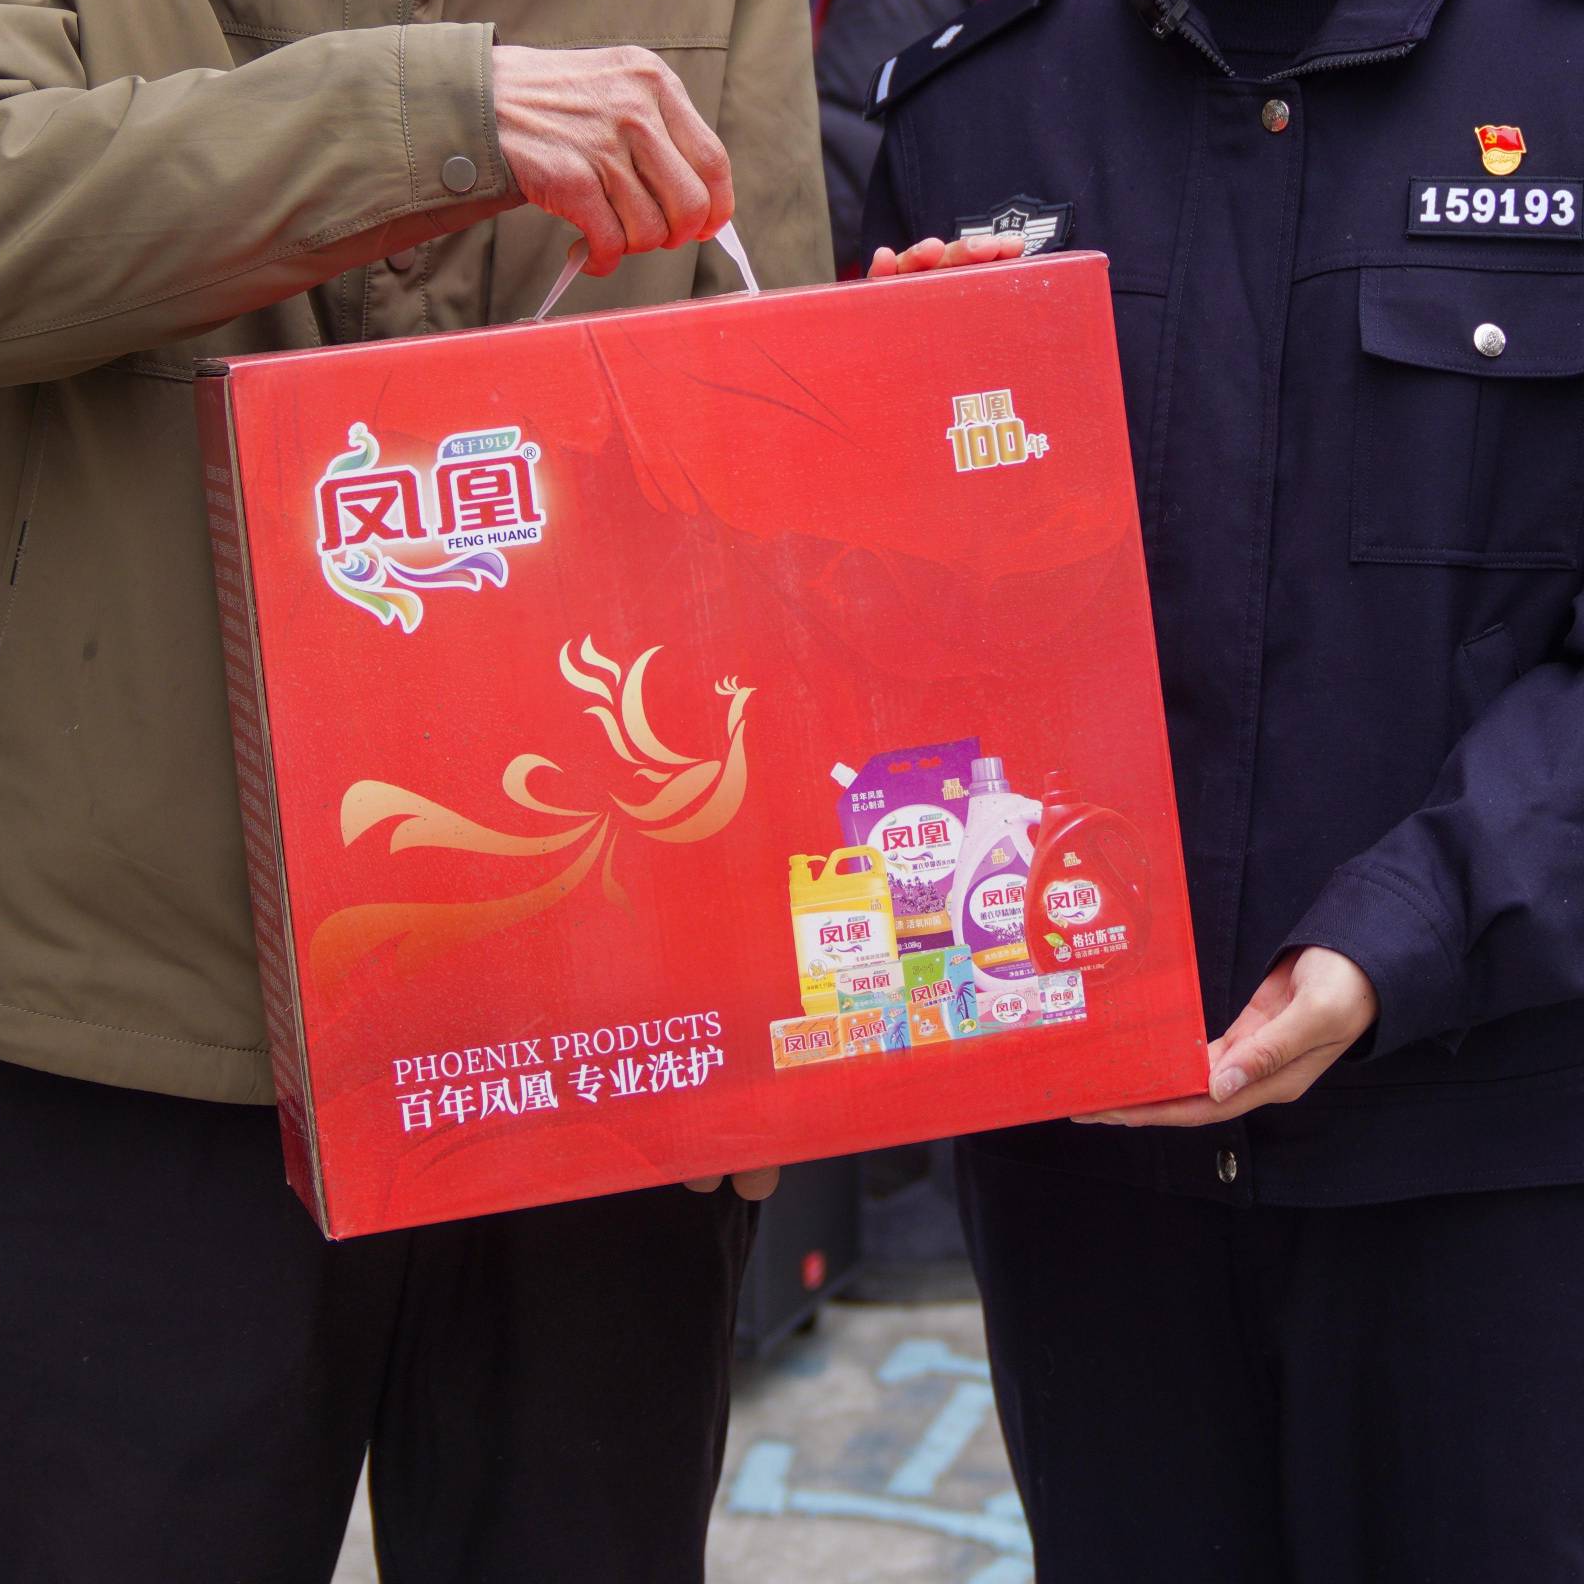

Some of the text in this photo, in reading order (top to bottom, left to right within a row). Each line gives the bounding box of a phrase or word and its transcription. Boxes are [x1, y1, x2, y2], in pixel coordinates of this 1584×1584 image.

[1419, 187, 1575, 226] 159193
[999, 216, 1022, 230] 浙江
[952, 389, 1016, 426] 凤凰
[450, 434, 510, 456] 始于1914
[946, 417, 1050, 473] 100年
[319, 454, 542, 552] 凤凰
[448, 527, 538, 550] FENG HUANG
[882, 819, 951, 852] 凤凰
[983, 886, 1025, 908] 凤凰
[1046, 886, 1098, 912] 凤凰
[819, 919, 872, 945] 凤凰
[852, 973, 890, 992] 凤凰
[911, 979, 954, 1003] 凤凰
[785, 1030, 832, 1053] 凤凰
[849, 1019, 888, 1041] 凤凰
[393, 1010, 723, 1086] PHOENIX PRODUCTS
[395, 1043, 725, 1133] 百年凤凰 专业洗护
